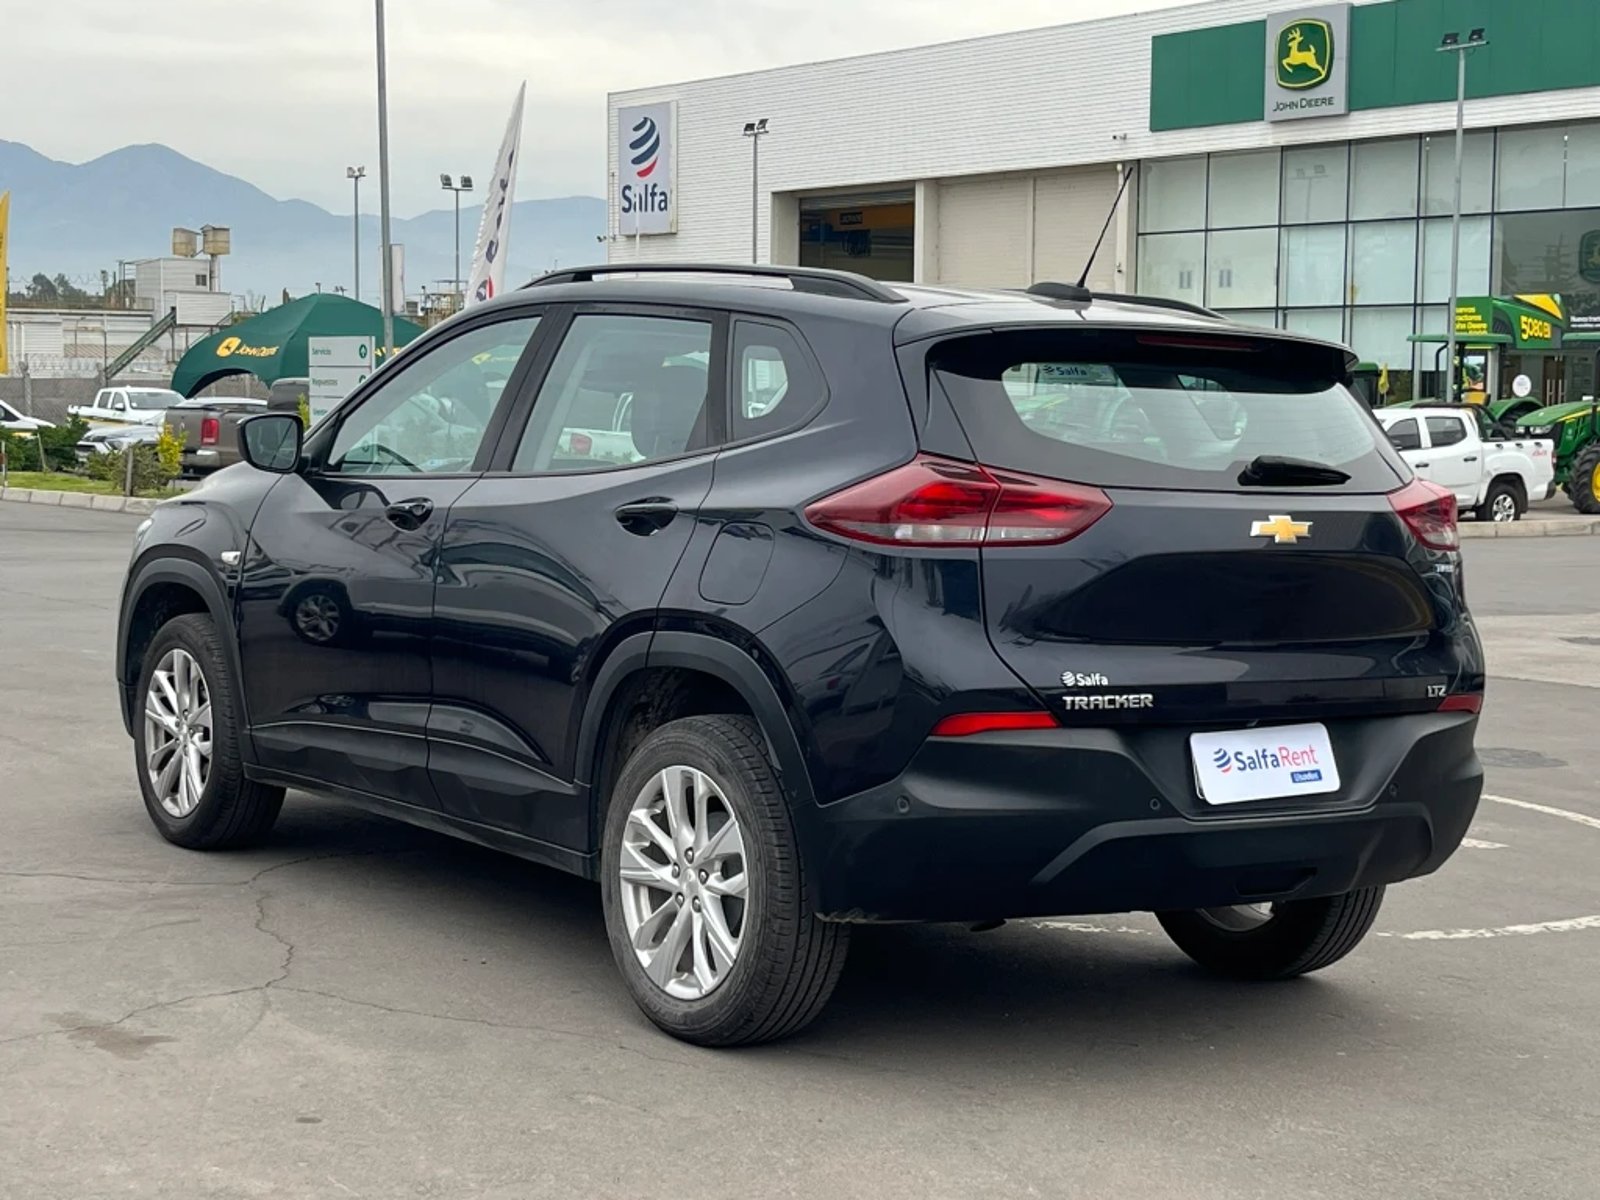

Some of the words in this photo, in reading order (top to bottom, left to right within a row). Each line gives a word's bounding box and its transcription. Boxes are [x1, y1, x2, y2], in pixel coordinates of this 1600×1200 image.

[1273, 101, 1299, 112] JOHN
[1300, 96, 1335, 108] DEERE
[621, 183, 668, 213] Salfa
[1056, 366, 1087, 376] Salfa
[1076, 673, 1109, 686] Salfa
[1427, 685, 1447, 697] LTZ
[1062, 693, 1154, 710] TRACKER
[1234, 744, 1319, 771] SalfaRent
